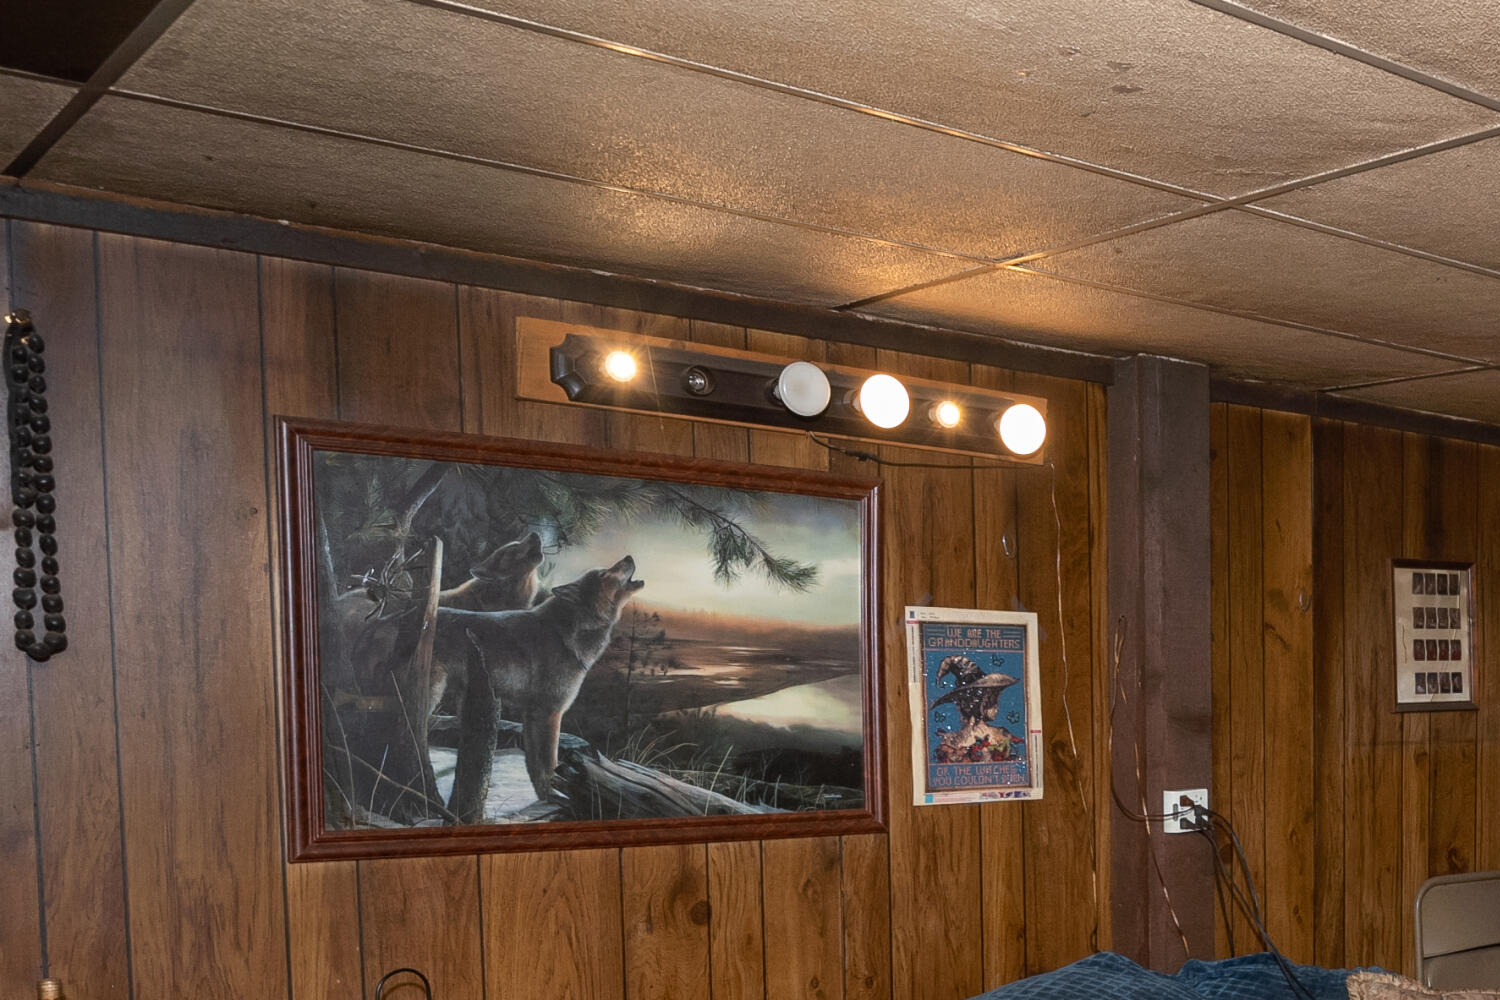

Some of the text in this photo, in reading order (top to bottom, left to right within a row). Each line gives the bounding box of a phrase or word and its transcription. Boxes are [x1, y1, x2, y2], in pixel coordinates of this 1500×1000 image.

[946, 628, 1001, 639] WE ARE THE
[928, 637, 1020, 649] GRANDDAUGHTERS
[936, 764, 1016, 777] OF THE WITCHES
[933, 776, 951, 787] YOU
[954, 774, 998, 786] COULDN'T
